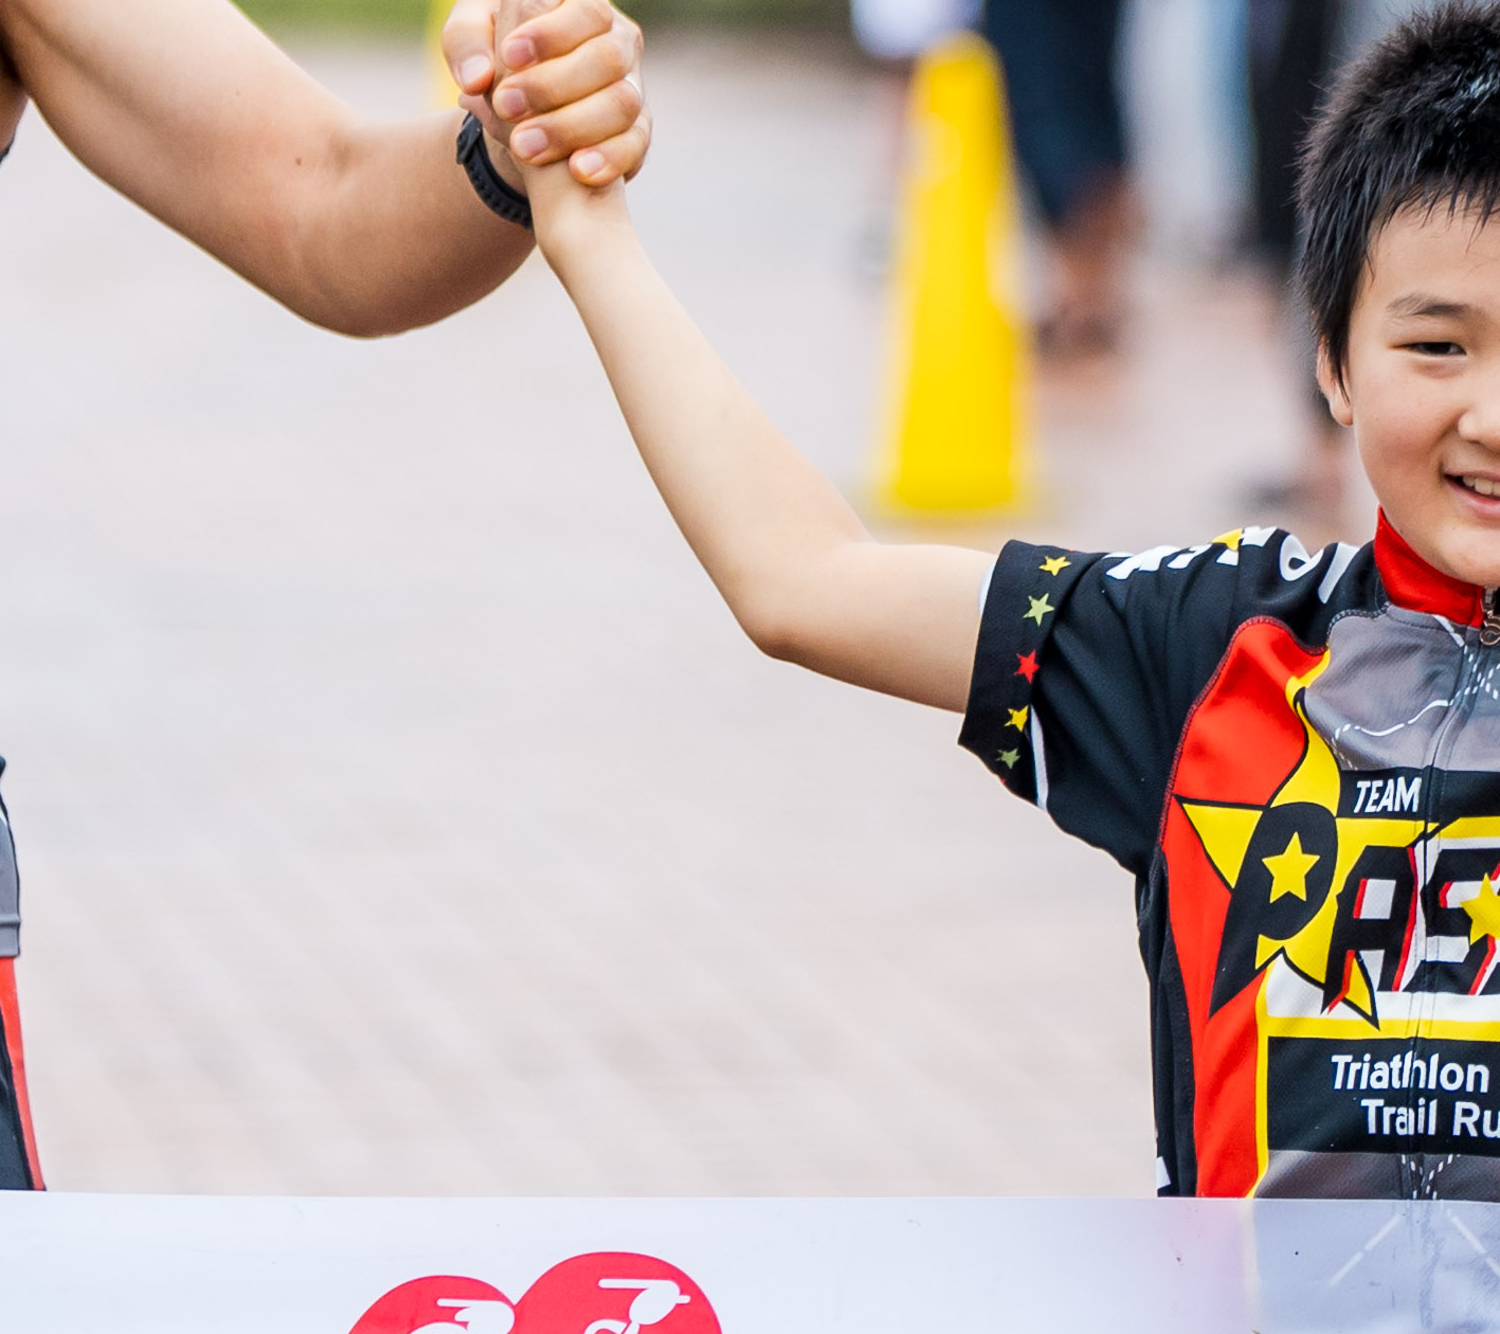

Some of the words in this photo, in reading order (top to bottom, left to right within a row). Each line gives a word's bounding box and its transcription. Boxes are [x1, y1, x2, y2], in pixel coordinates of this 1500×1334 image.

[1354, 777, 1421, 814] TEAM
[1331, 1052, 1490, 1094] Triathlon
[1360, 1098, 1438, 1136] Trail
